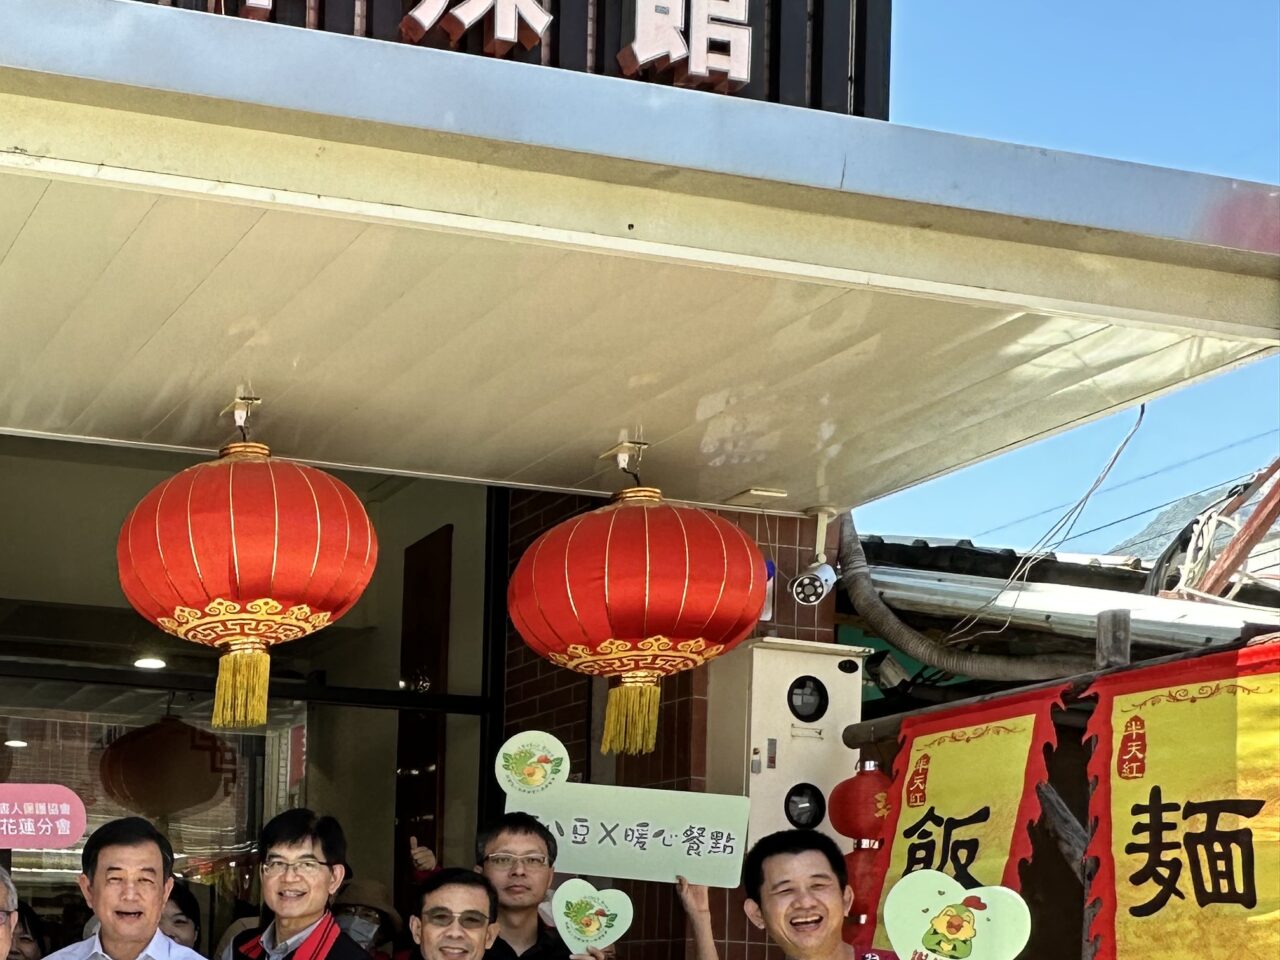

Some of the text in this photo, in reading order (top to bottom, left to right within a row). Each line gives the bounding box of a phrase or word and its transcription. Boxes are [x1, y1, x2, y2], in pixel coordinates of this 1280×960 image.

[1122, 720, 1144, 779] 半天紅
[901, 805, 991, 890] 飯
